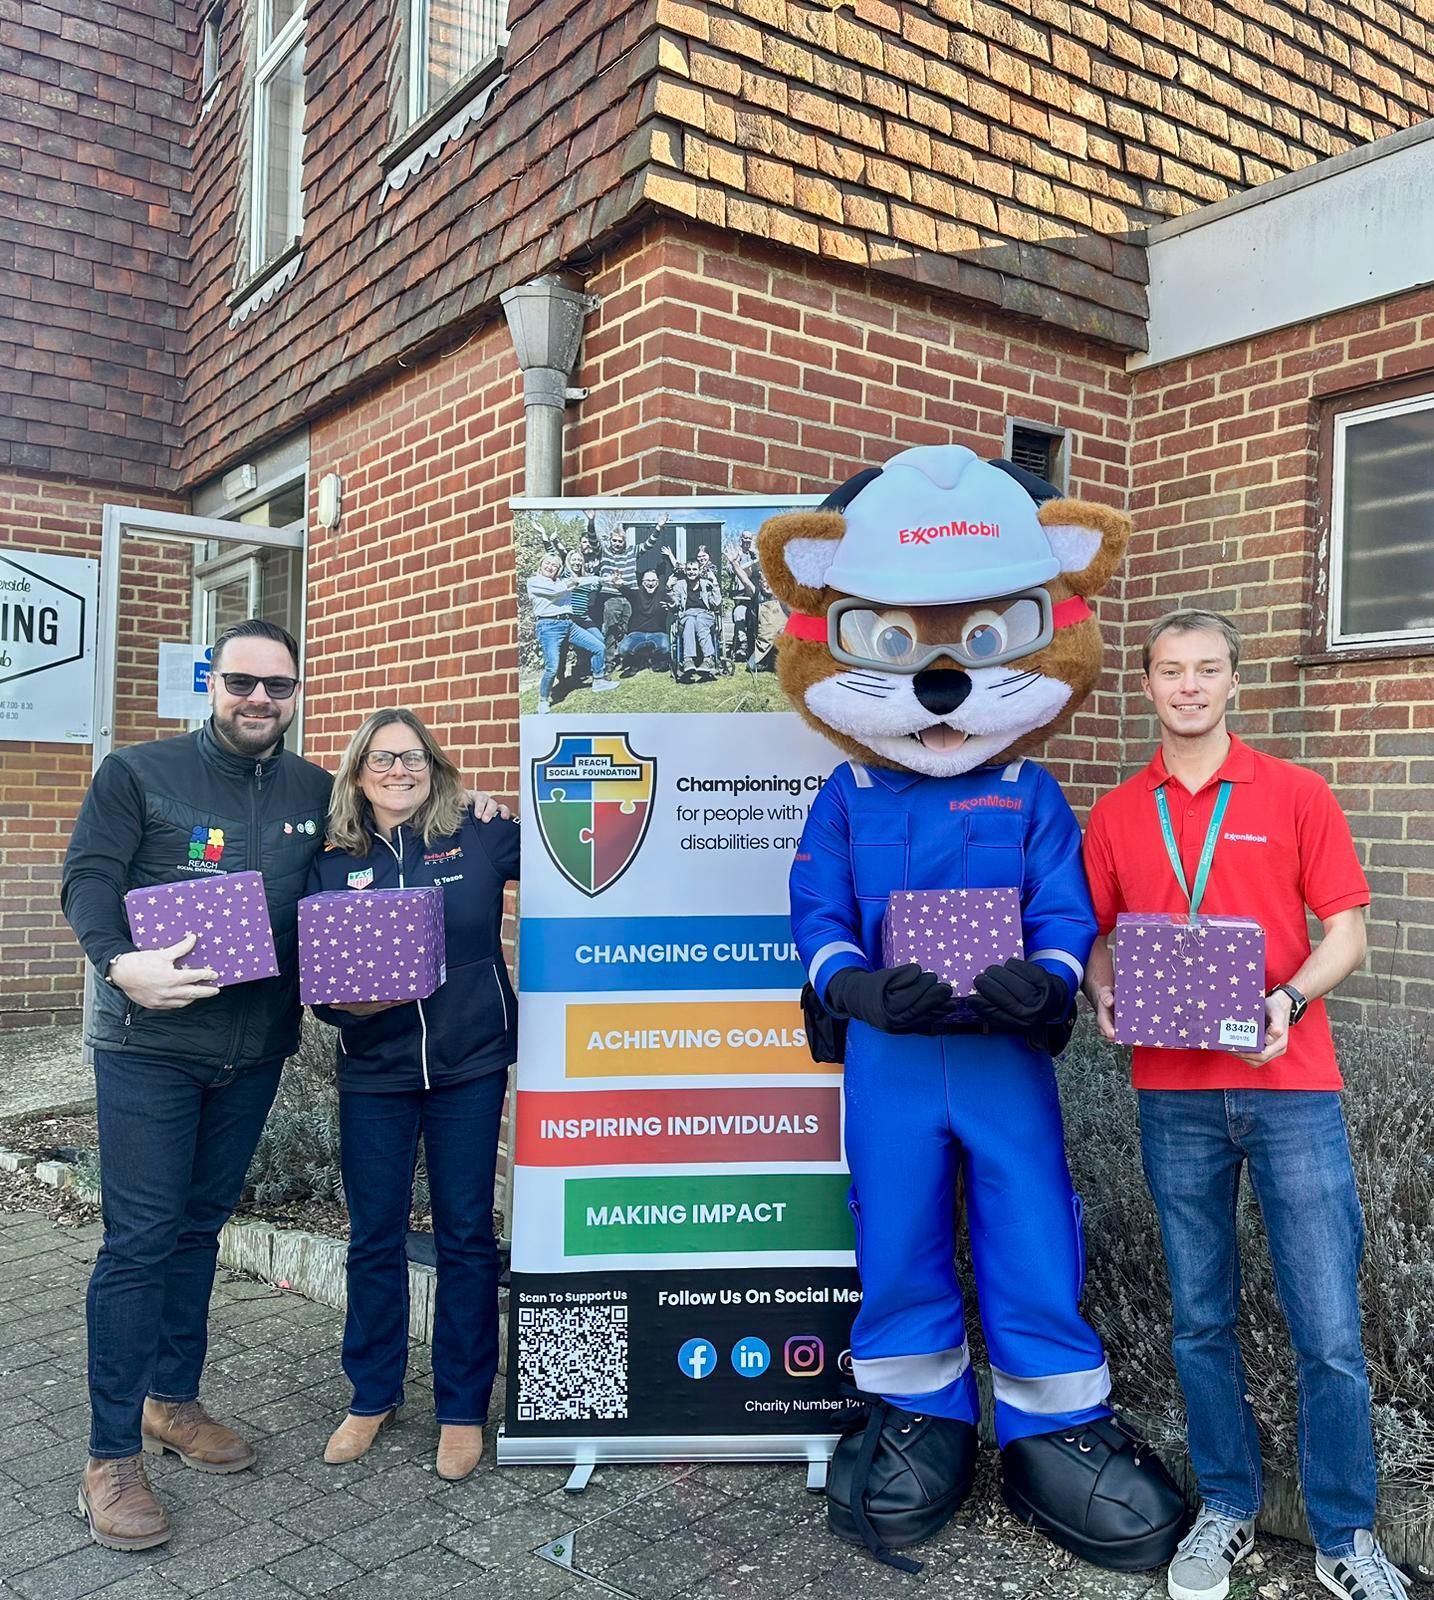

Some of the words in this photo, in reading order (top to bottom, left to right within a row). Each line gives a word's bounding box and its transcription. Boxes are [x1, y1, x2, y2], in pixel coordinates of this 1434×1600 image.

[899, 520, 1000, 545] ExxonMobil
[578, 759, 608, 767] REACH
[549, 769, 580, 777] SOCIAL
[582, 768, 637, 776] FOUNDATION
[676, 775, 801, 797] Championing
[804, 775, 829, 791] Ch
[950, 795, 1022, 812] ExxonMobil
[676, 805, 700, 821] for
[703, 804, 764, 826] people
[767, 804, 803, 820] with
[680, 834, 769, 850] disabilities
[1224, 832, 1267, 843] ExxonMobil
[188, 859, 218, 869] REACH
[575, 944, 708, 964] CHANGING
[1225, 1023, 1256, 1034] 83420
[587, 1029, 721, 1050] ACHIEVING
[726, 1028, 806, 1048] GOALS
[540, 1116, 662, 1139] INSPIRING
[667, 1115, 819, 1136] INDIVIDUALS
[586, 1205, 687, 1226] MAKING
[692, 1203, 787, 1224] IMPACT
[519, 1292, 547, 1303] Scan
[549, 1293, 563, 1303] To
[564, 1290, 612, 1304] Support
[613, 1290, 628, 1300] Us
[658, 1290, 716, 1306] Follow
[719, 1289, 742, 1305] Us
[745, 1289, 771, 1304] On
[774, 1287, 829, 1303] Social
[745, 1399, 790, 1414] Charity
[793, 1399, 843, 1411] Number
